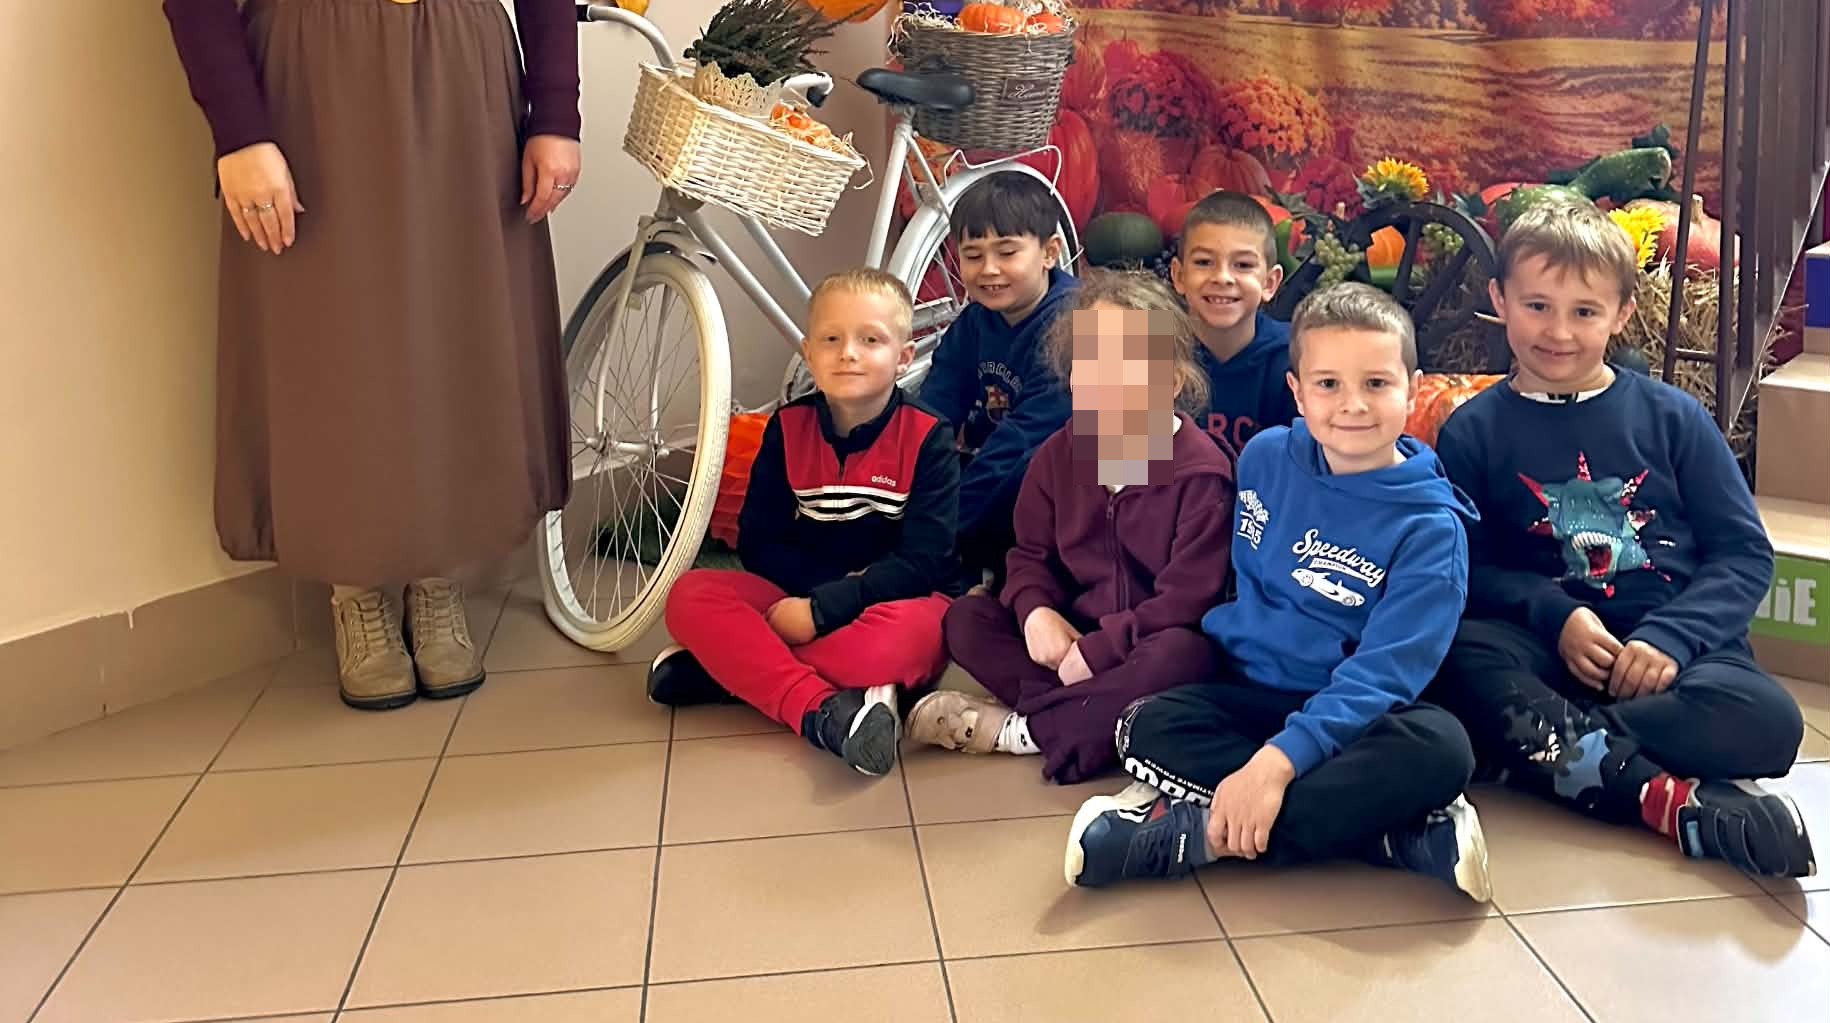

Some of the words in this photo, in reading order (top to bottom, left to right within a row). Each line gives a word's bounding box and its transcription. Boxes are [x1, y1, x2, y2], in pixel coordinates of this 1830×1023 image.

[871, 475, 897, 487] adidas
[1292, 528, 1386, 588] Speedway
[1144, 759, 1176, 780] POWER
[1176, 777, 1214, 796] LTIMATE
